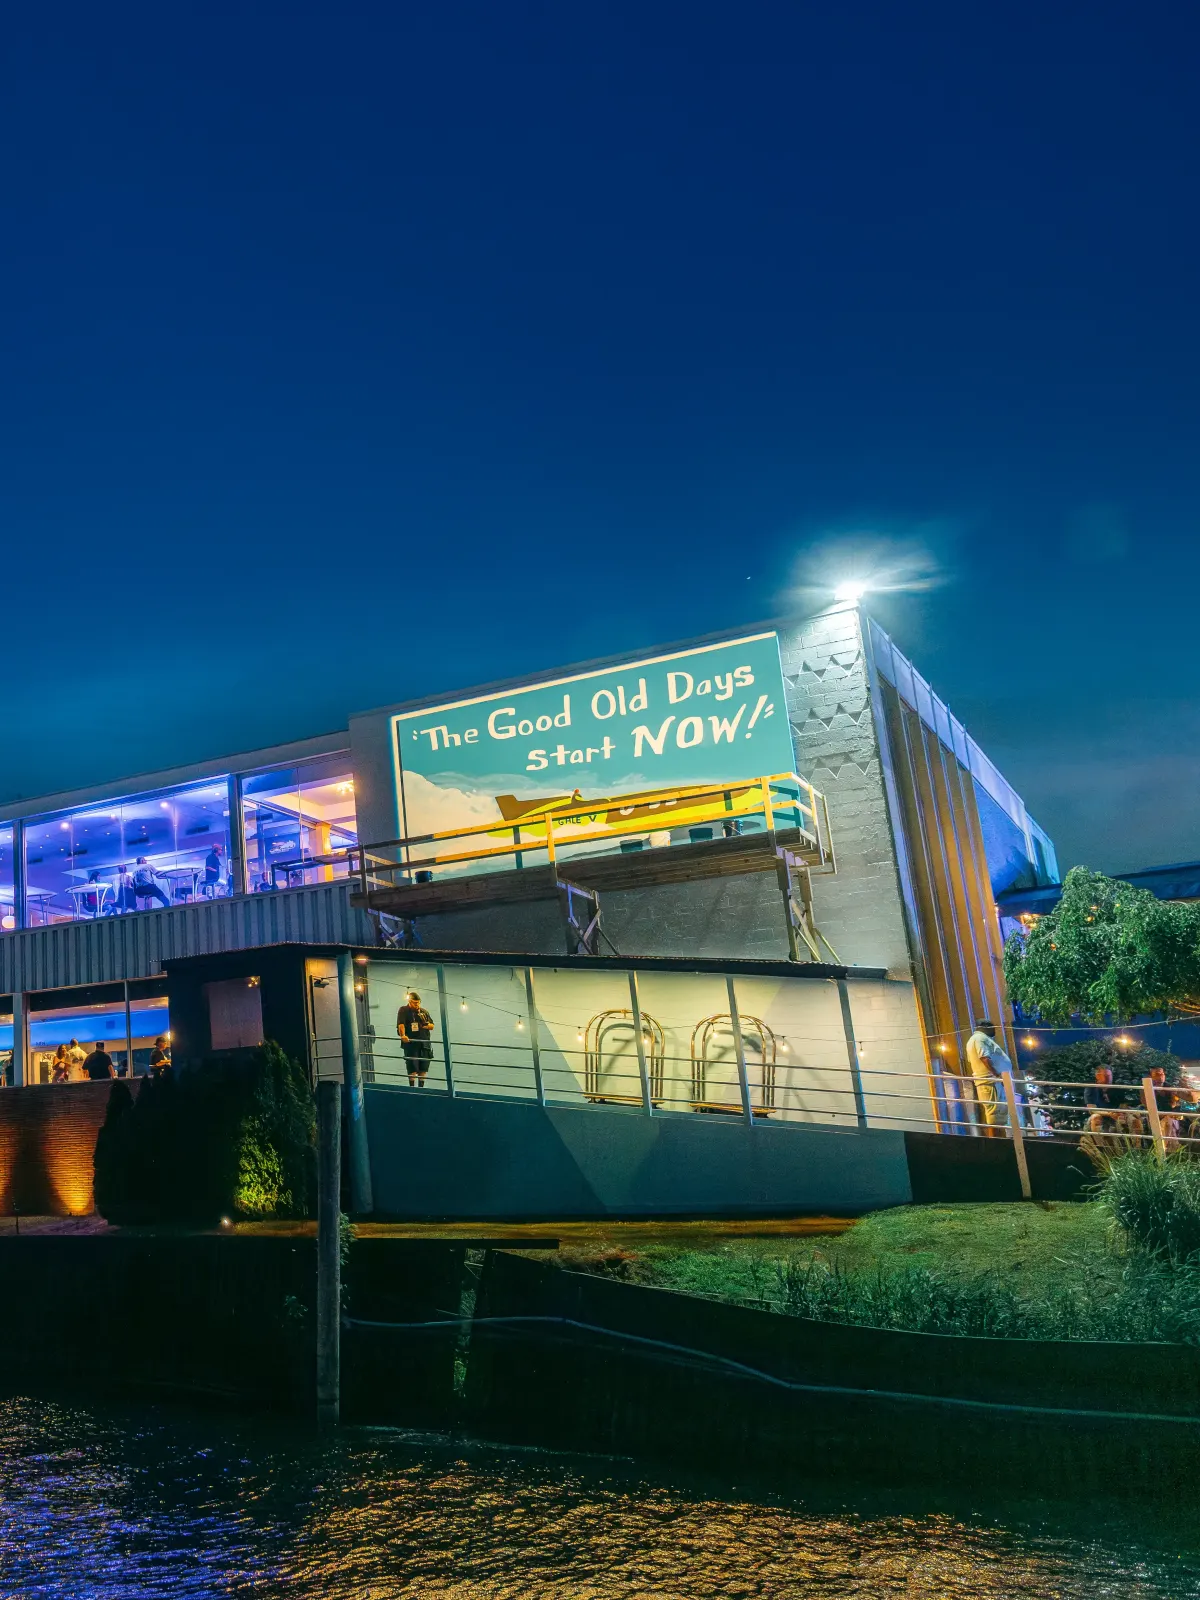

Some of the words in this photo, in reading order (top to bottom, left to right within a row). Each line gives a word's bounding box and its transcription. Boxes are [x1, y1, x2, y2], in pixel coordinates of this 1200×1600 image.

[487, 694, 572, 740] Good
[591, 677, 648, 720] Old
[666, 665, 755, 701] Days
